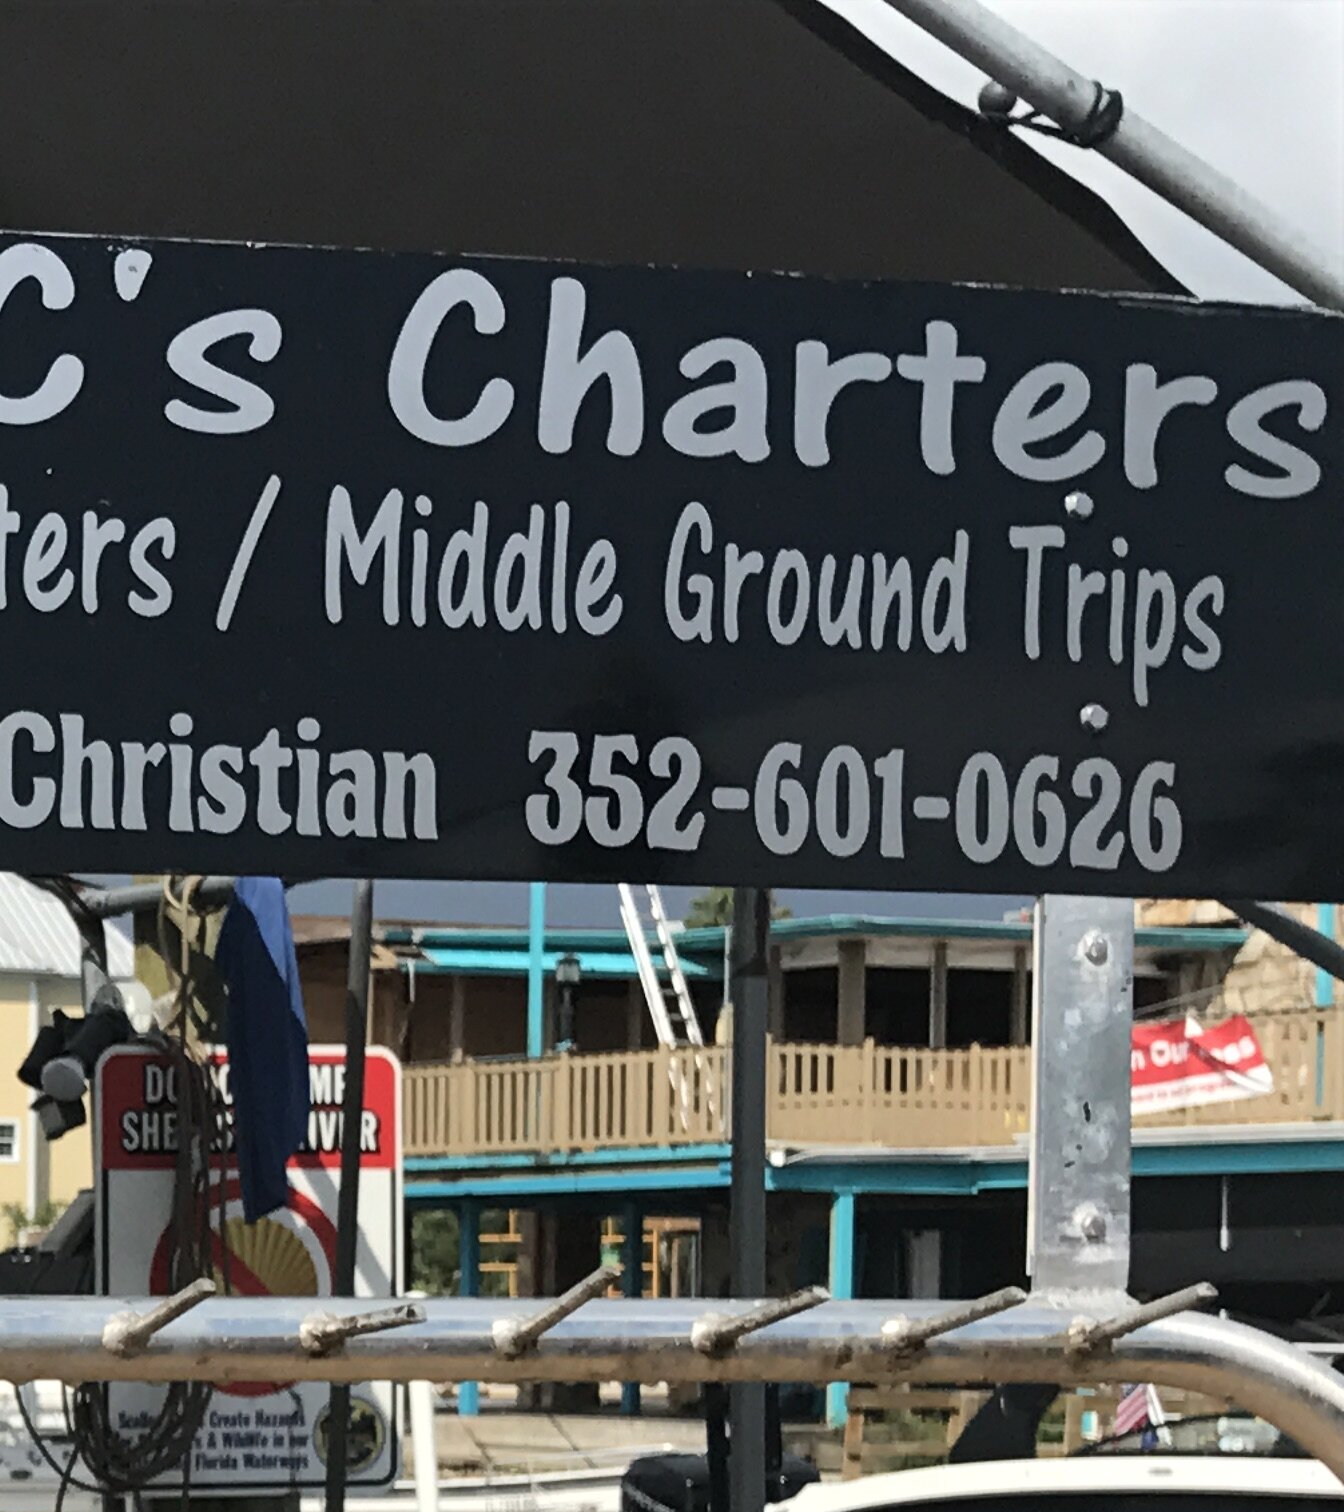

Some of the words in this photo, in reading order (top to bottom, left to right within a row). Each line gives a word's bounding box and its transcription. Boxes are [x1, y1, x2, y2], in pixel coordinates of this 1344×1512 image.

[387, 267, 1328, 499] Charters
[216, 474, 282, 632] /
[325, 484, 623, 636] Middle
[664, 501, 969, 654] Ground
[1008, 525, 1225, 706] Trips
[525, 730, 1182, 872] 352-601-0626
